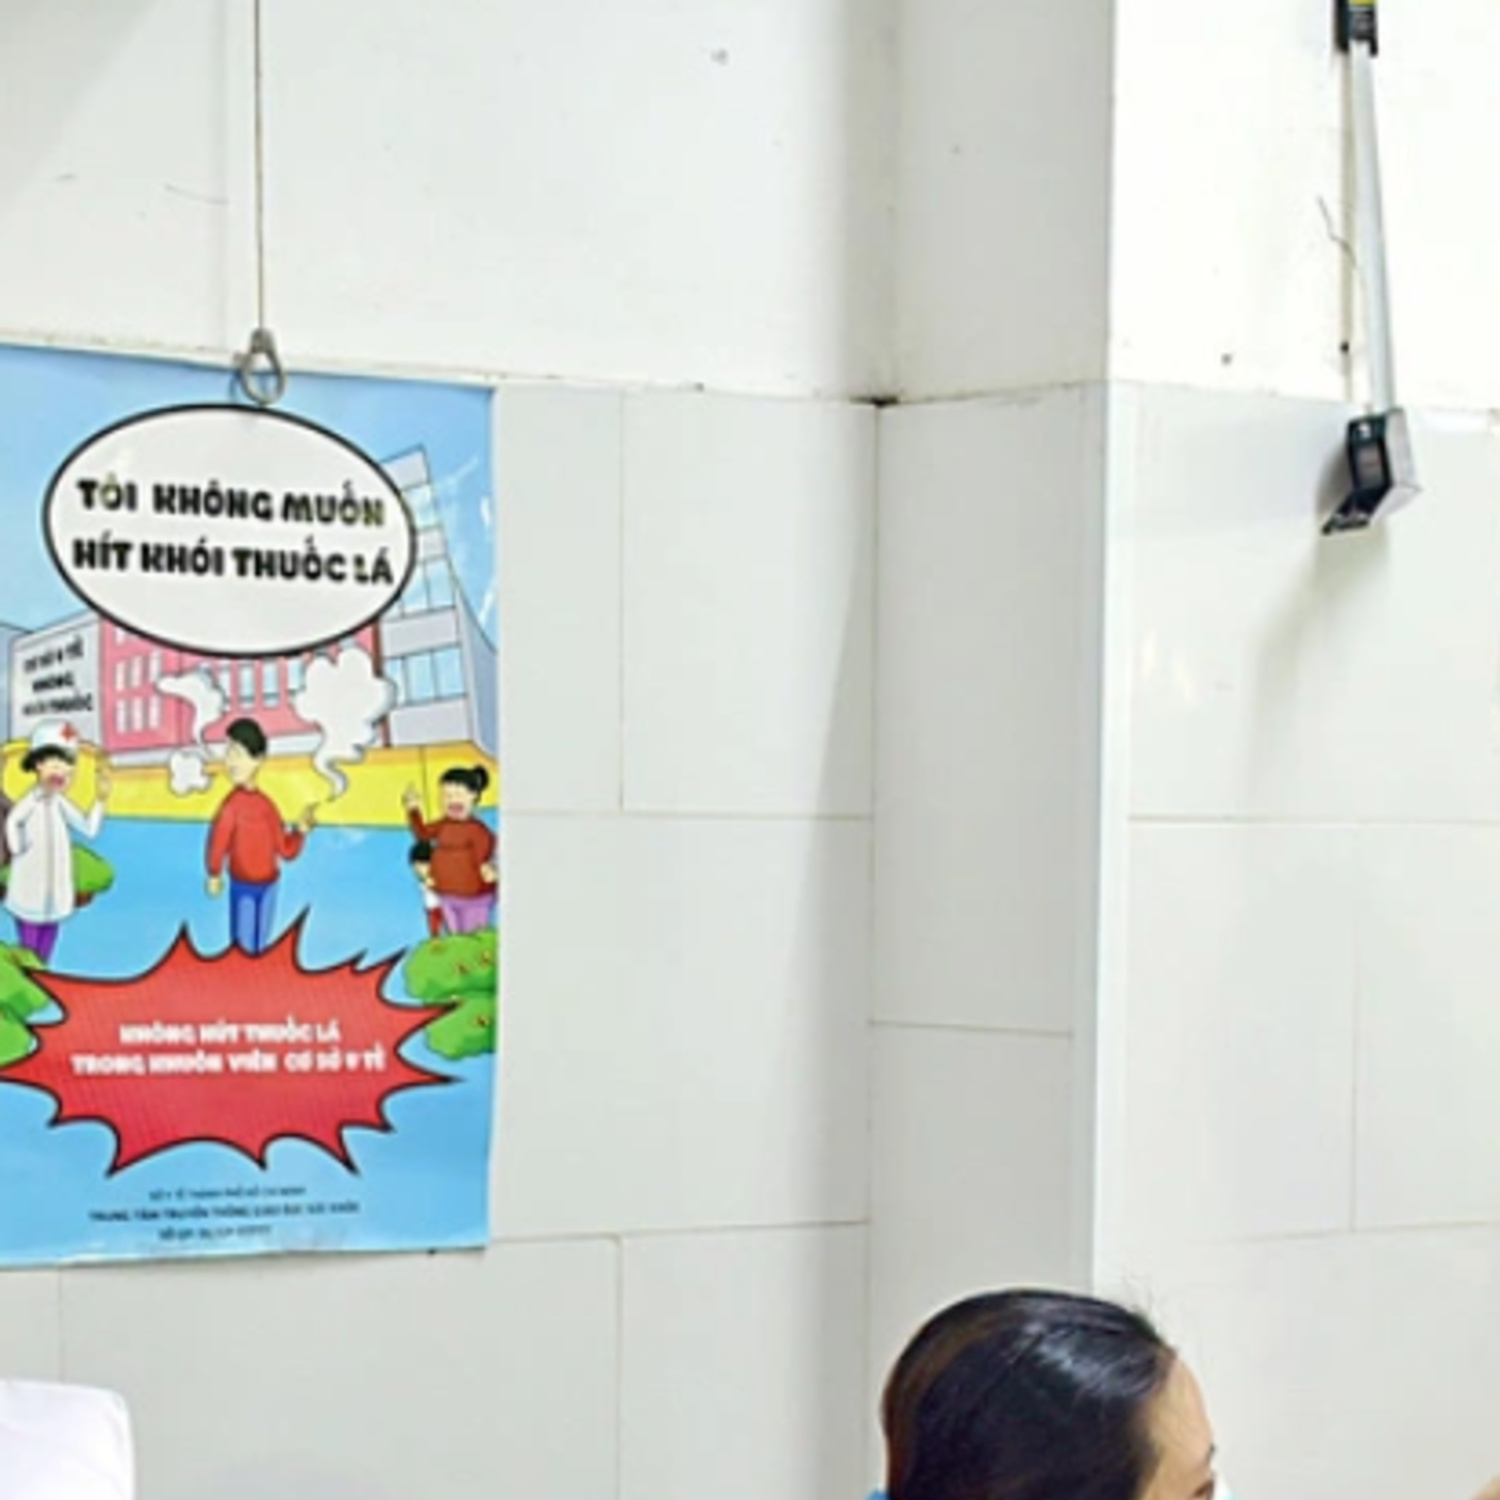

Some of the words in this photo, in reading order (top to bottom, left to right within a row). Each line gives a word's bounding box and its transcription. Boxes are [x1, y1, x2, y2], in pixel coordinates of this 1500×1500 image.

[77, 472, 138, 513] TÔI
[152, 478, 273, 521] KHÔNG
[280, 480, 385, 527] MUỐN
[72, 529, 133, 571] HÍT
[140, 534, 225, 577] KHÓI
[231, 534, 347, 583] THUỐC
[352, 547, 395, 585] LÁ
[119, 1020, 197, 1045] KHÔNG
[244, 1014, 313, 1044] THUỐC
[315, 1018, 341, 1043] LÁ
[70, 1052, 146, 1076] TRONG
